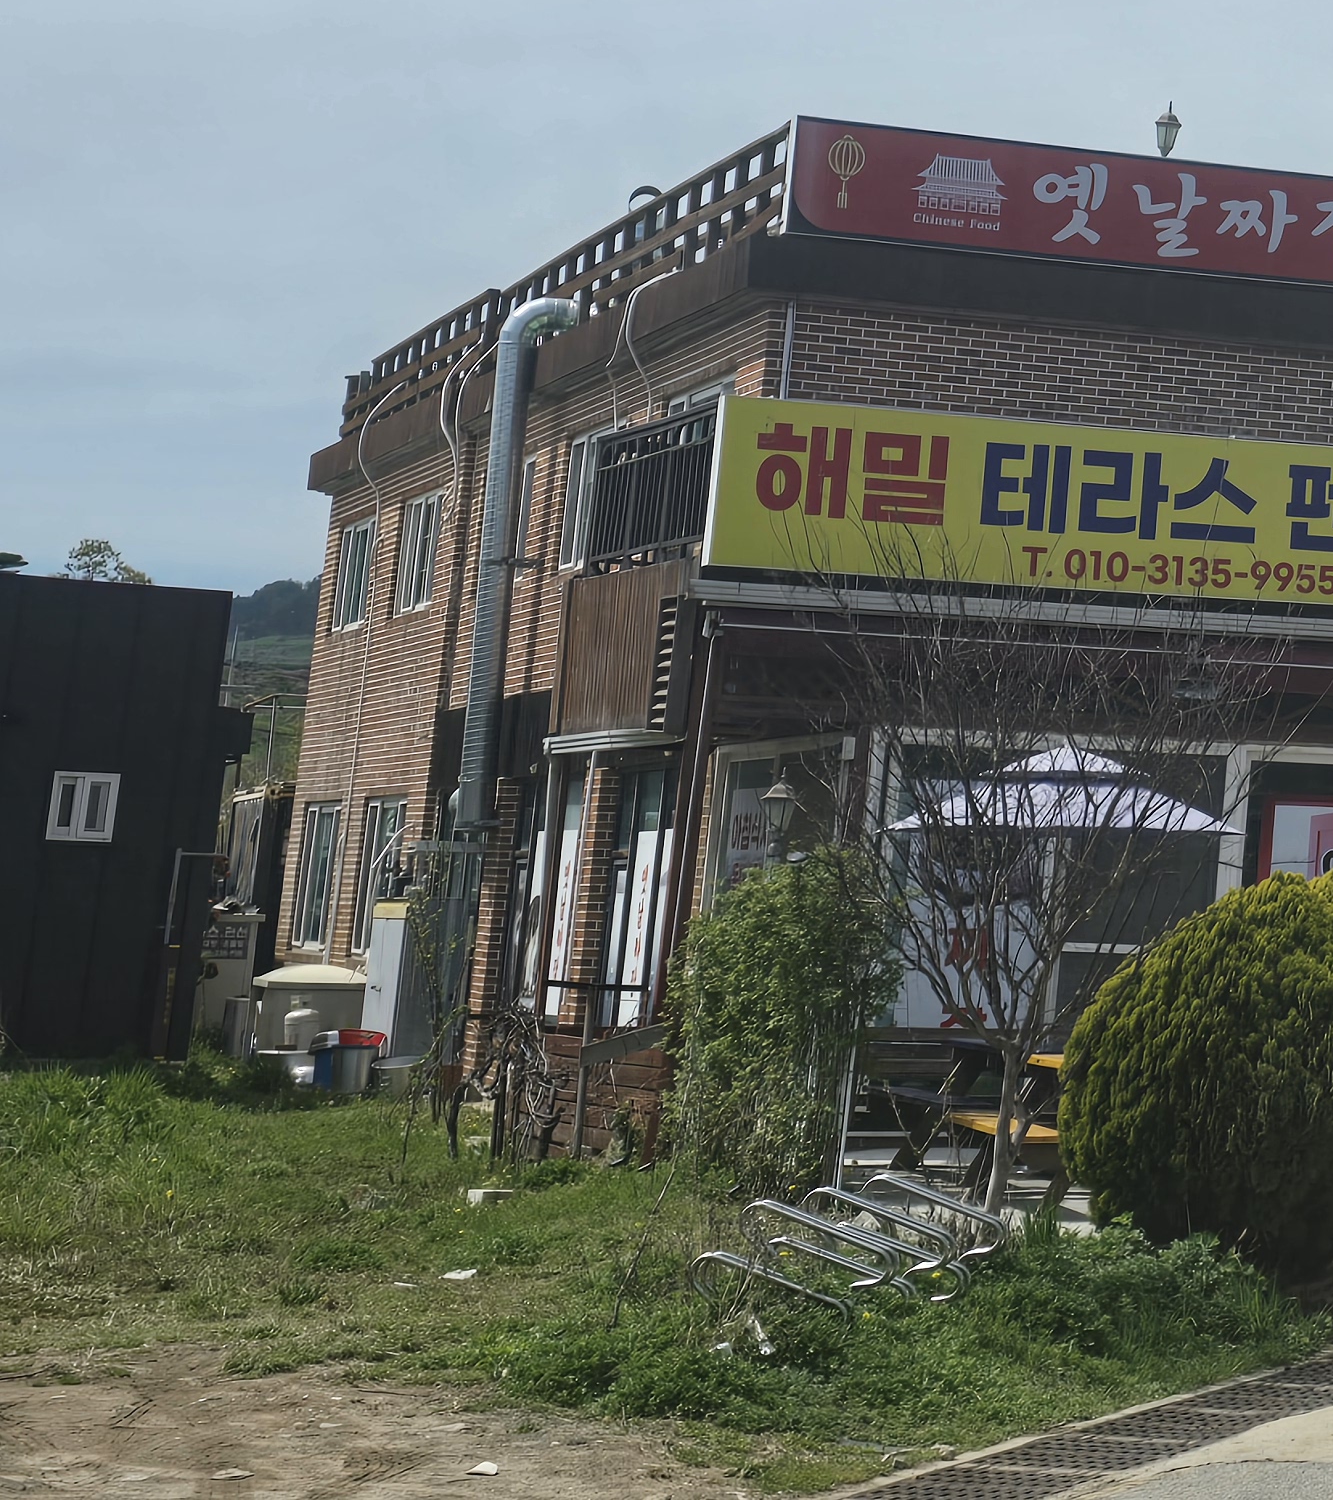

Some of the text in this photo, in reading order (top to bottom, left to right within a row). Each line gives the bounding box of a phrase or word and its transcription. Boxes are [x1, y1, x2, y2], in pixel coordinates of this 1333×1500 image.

[913, 212, 1001, 232] Chinese Food
[756, 422, 950, 526] 해밀
[980, 441, 1258, 544] 테라스
